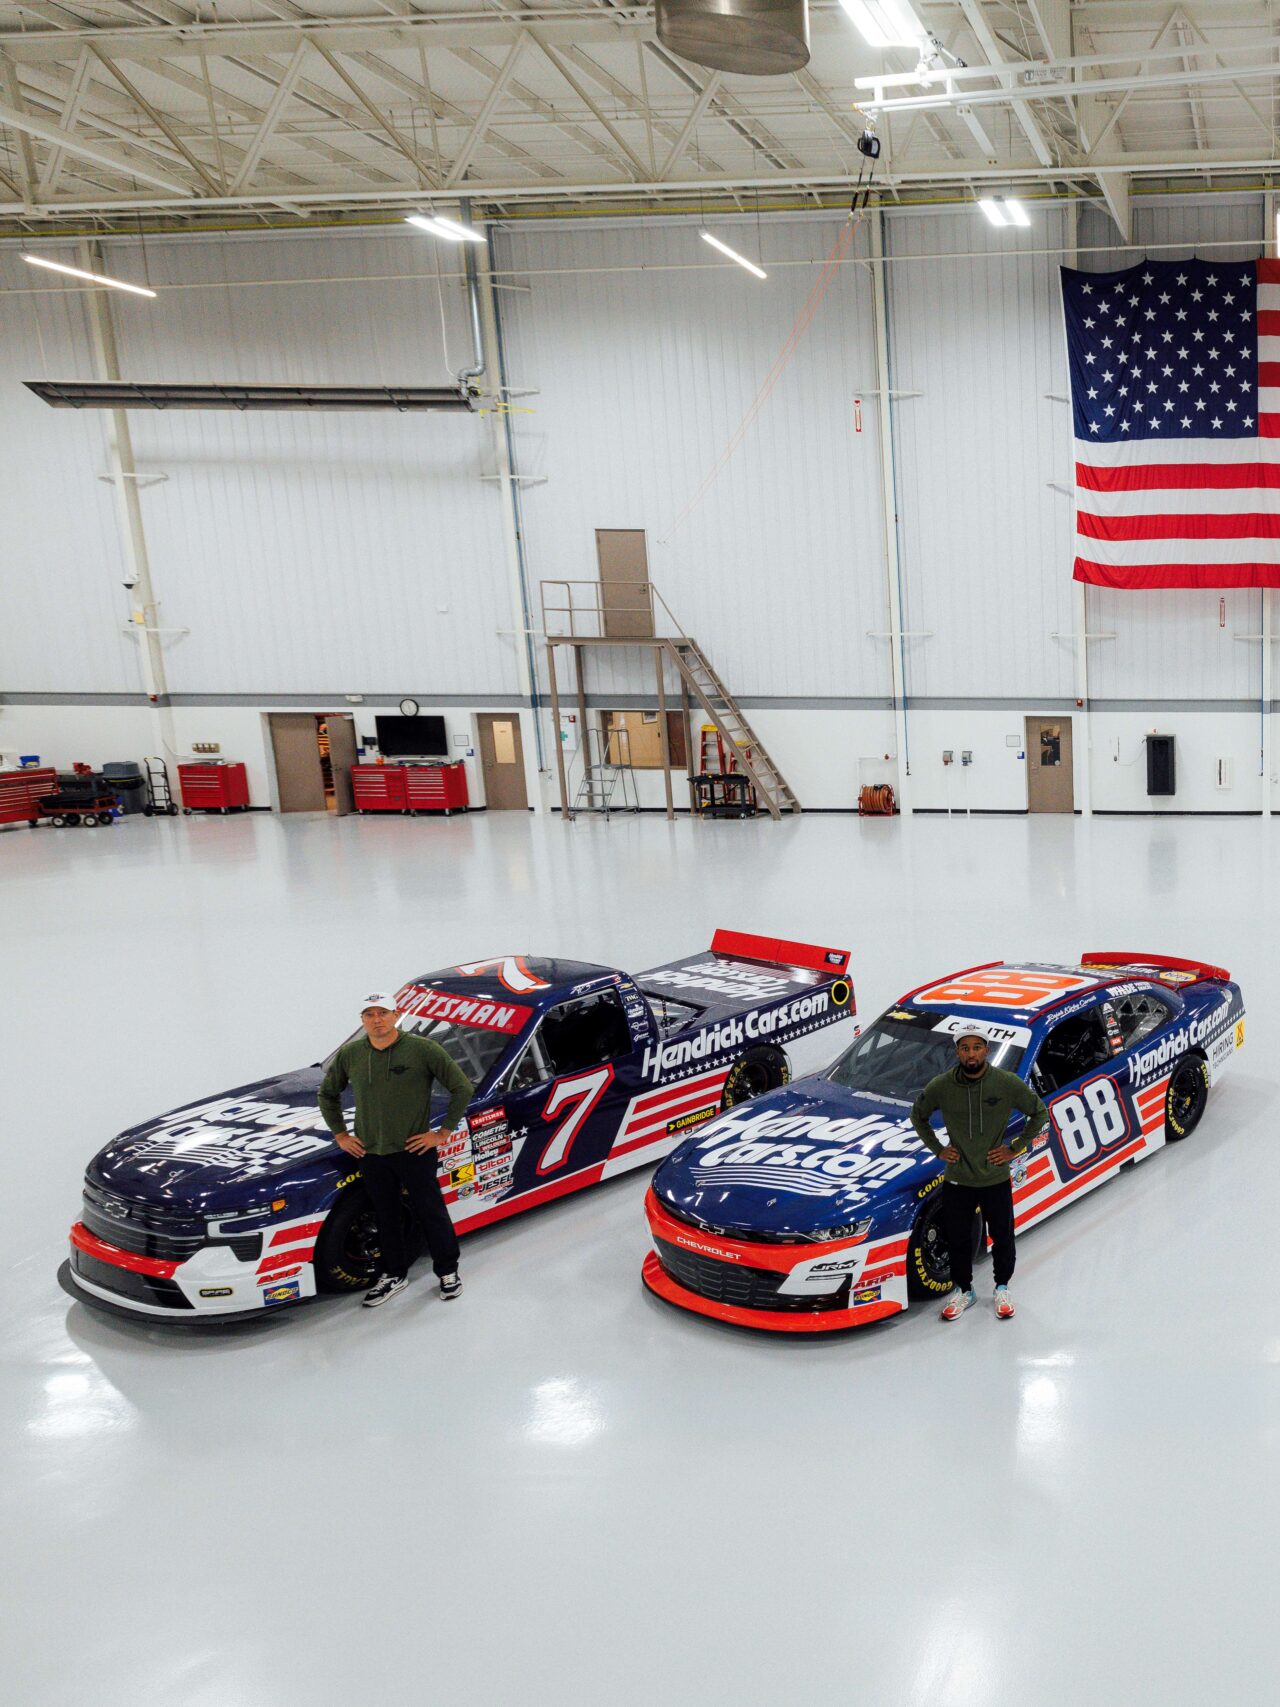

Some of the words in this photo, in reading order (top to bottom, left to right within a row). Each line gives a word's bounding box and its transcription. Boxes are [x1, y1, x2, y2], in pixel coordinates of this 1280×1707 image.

[455, 955, 551, 994] 7
[919, 970, 1085, 1005] 88
[396, 987, 517, 1028] CRAFTSMAN
[1213, 1032, 1233, 1061] HIRING
[472, 1110, 504, 1125] CRAFTSMAN
[537, 1063, 614, 1176] 7
[676, 1107, 715, 1129] GAINBRIDGE
[1052, 1078, 1126, 1165] 88
[473, 1124, 507, 1140] COMETIC
[475, 1133, 504, 1148] LINCOLN
[475, 1149, 498, 1162] Holley
[480, 1156, 511, 1171] tilton
[699, 1143, 917, 1180] Cars.com
[479, 1176, 514, 1192] JESEL
[917, 1174, 945, 1199] GOOD
[677, 1236, 742, 1260] CHEVROLET
[257, 1266, 302, 1284] ARP
[811, 1260, 857, 1272] JRM
[914, 1247, 953, 1293] GOODYEAR
[851, 1272, 894, 1290] ARP
[266, 1287, 300, 1300] SUNOCO
